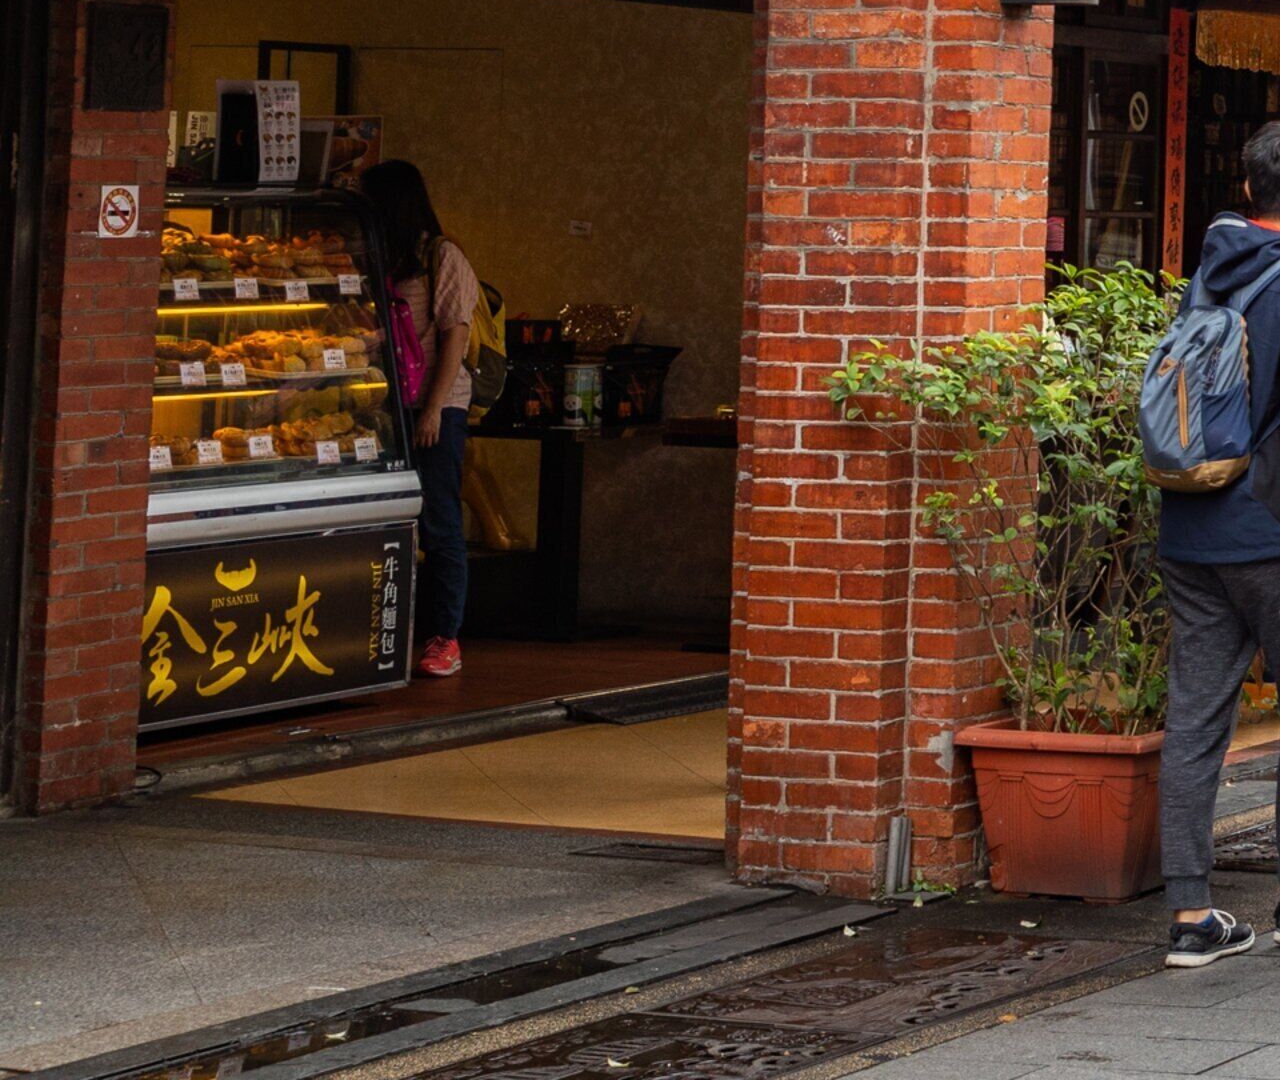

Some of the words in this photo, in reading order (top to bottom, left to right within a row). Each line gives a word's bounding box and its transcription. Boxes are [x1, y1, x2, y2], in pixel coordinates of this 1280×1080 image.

[370, 561, 382, 590] JIN
[210, 597, 225, 612] JIN
[226, 595, 244, 609] SAN
[244, 592, 260, 605] XIA
[370, 593, 382, 636] SAN
[140, 574, 335, 706] 金三峽
[368, 636, 381, 662] XIA
